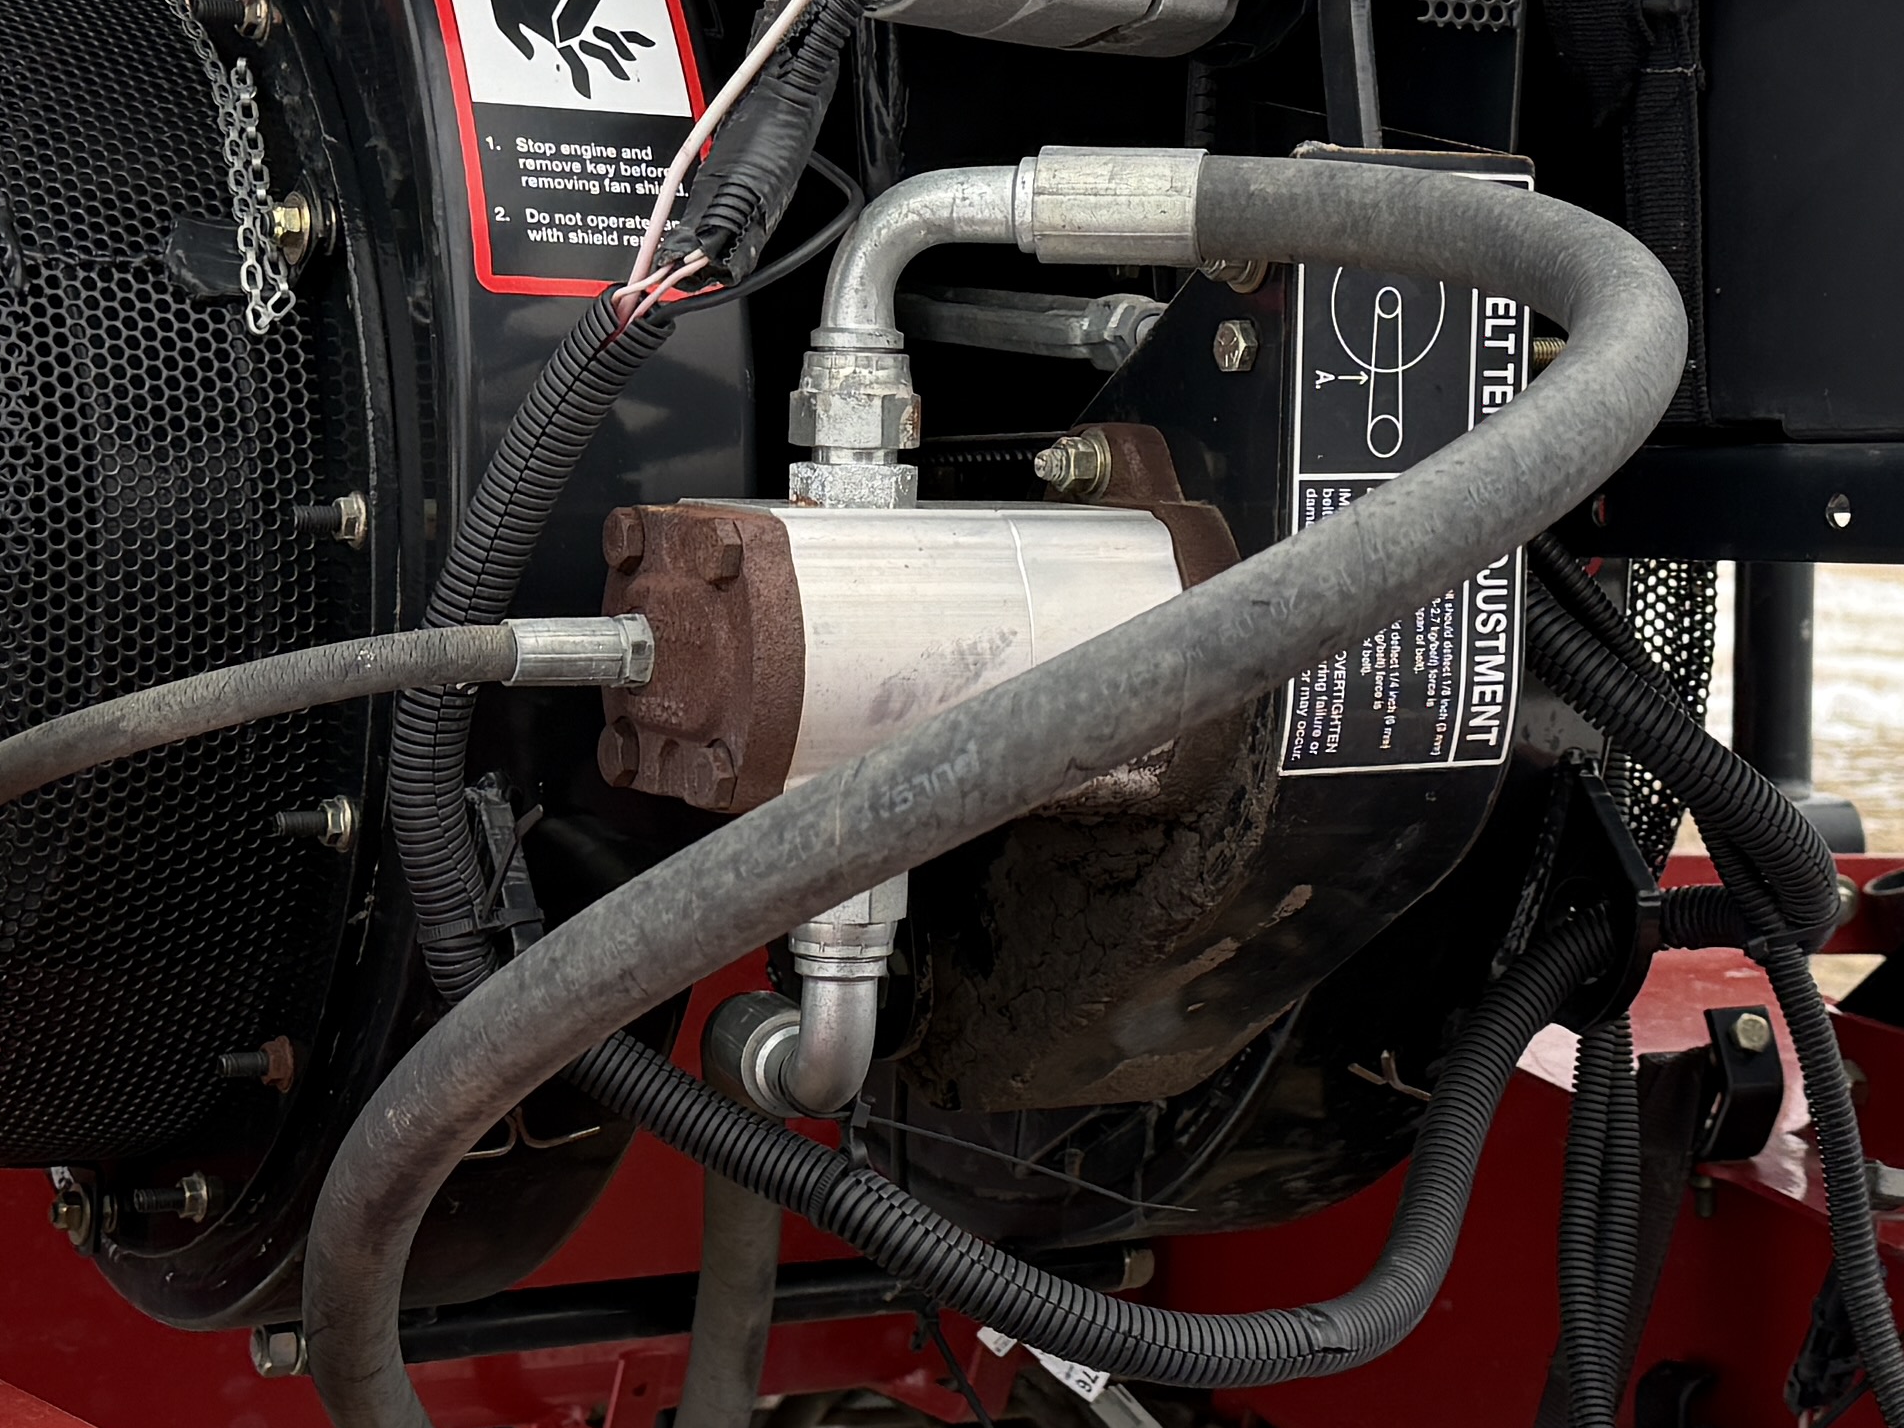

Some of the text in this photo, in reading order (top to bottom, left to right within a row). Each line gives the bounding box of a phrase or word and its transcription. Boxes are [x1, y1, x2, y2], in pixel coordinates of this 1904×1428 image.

[486, 135, 653, 160] 1. Stop engine and
[519, 157, 582, 173] remove
[587, 159, 615, 177] key
[521, 174, 599, 194] removing
[604, 177, 630, 194] fan
[494, 207, 511, 221] 2.
[526, 208, 550, 224] Do
[555, 212, 581, 226] not
[528, 228, 564, 243] with
[569, 230, 618, 246] shield
[1484, 297, 1516, 354] ELT
[1316, 370, 1335, 389] A.
[1322, 489, 1335, 520] belt
[1444, 603, 1453, 638] should
[1390, 632, 1401, 668] deflect
[1415, 634, 1426, 646] of
[1442, 641, 1452, 676] deflect
[1466, 558, 1508, 746] JUSTMENT
[1375, 672, 1385, 698] force
[1389, 672, 1399, 687] 1/4
[1427, 669, 1438, 695] force
[1441, 680, 1451, 695] 1/8
[1296, 687, 1310, 716] may
[1373, 701, 1383, 709] is
[1387, 691, 1399, 713] inch
[1426, 699, 1437, 708] is
[1439, 699, 1450, 720] inch
[1311, 696, 1328, 737] failure
[1291, 721, 1306, 761] occur.
[1309, 741, 1318, 754] or
